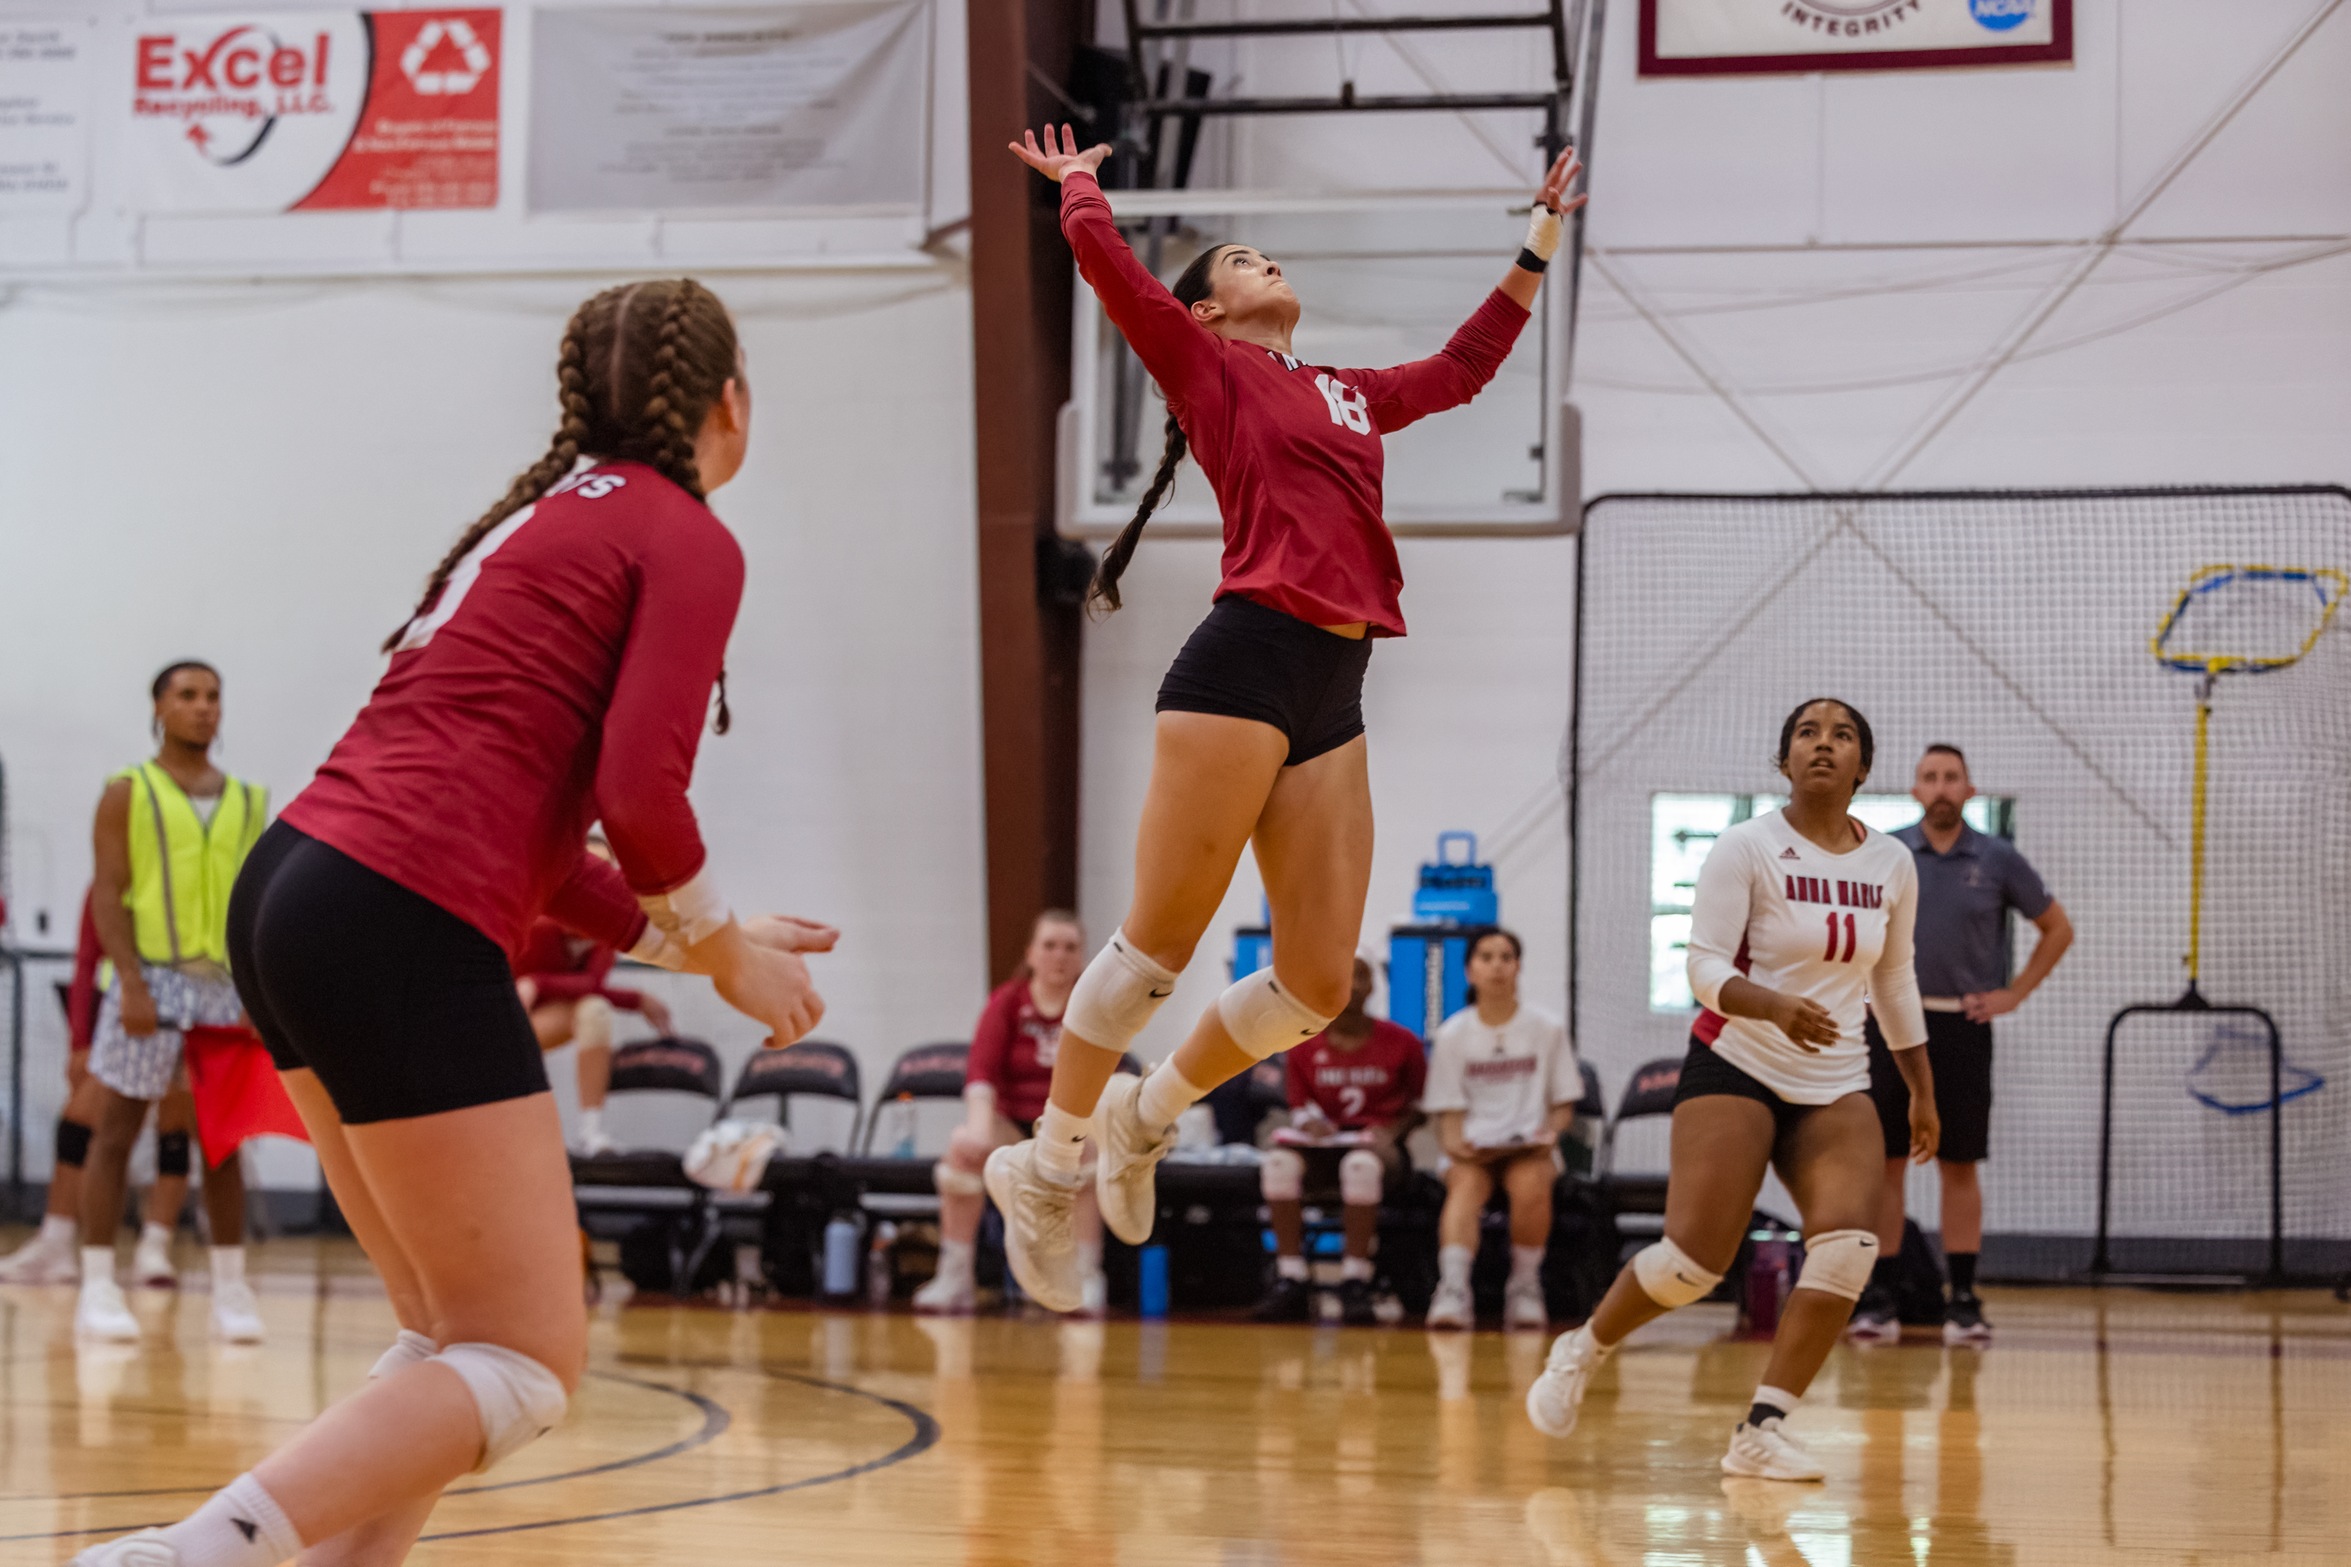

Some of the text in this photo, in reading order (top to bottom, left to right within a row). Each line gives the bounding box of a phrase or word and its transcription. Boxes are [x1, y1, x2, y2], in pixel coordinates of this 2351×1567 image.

[1781, 0, 1920, 36] INTEGRITY
[136, 31, 330, 89] Excel
[1314, 373, 1371, 436] 18
[1786, 874, 1832, 905] ANNA
[1823, 911, 1857, 963] 11
